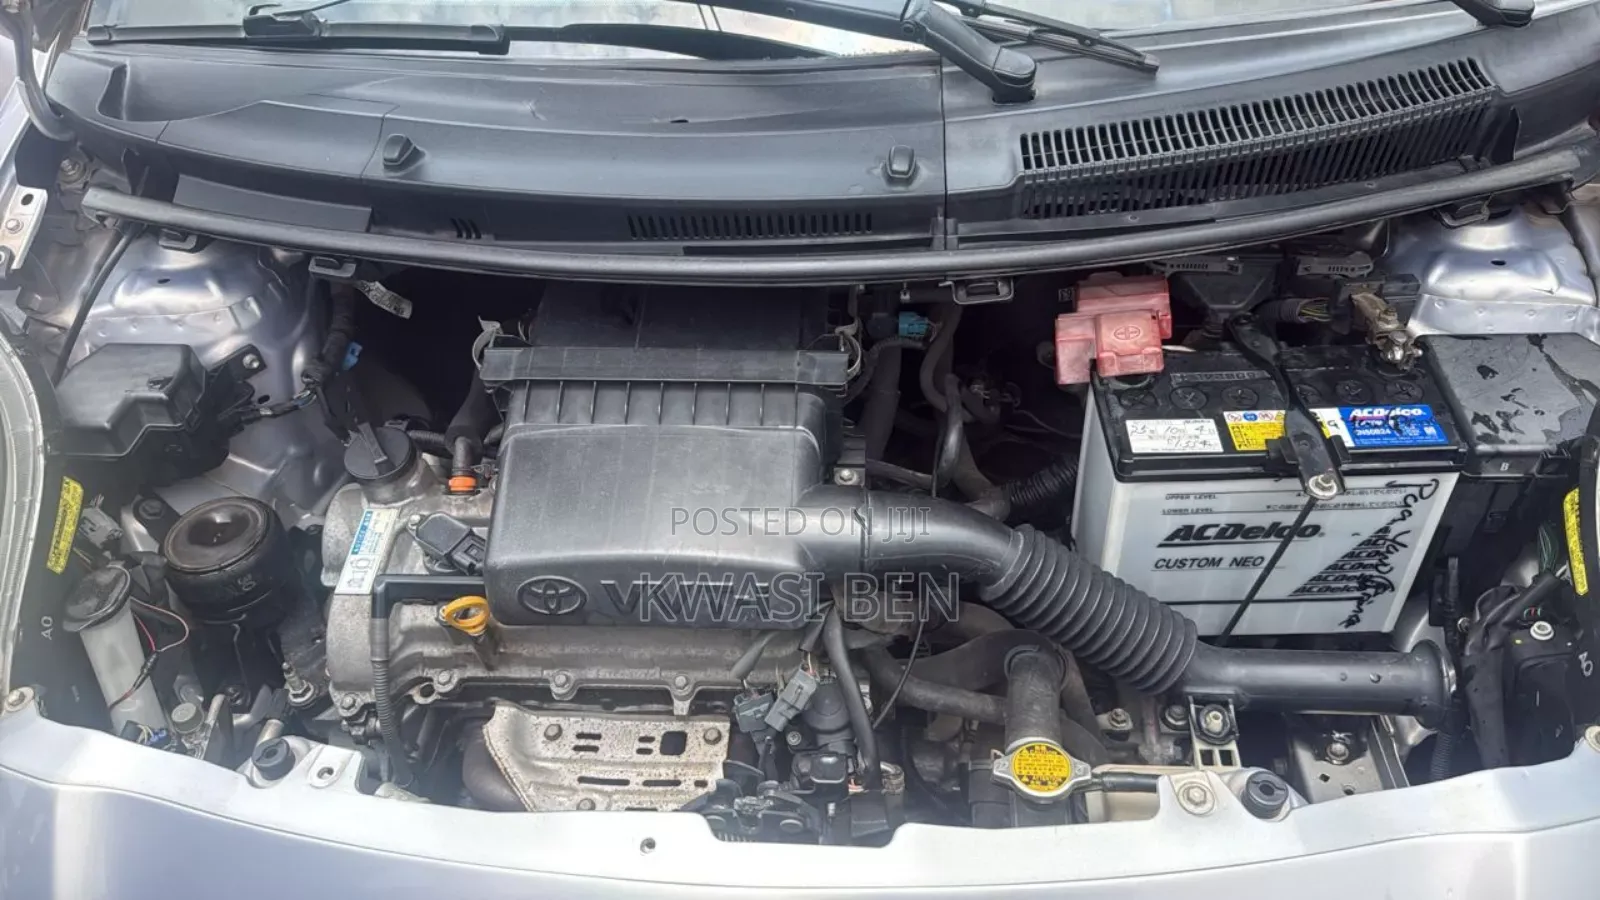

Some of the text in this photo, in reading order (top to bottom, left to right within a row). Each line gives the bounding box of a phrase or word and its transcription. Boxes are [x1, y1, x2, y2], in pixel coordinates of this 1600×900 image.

[1194, 492, 1217, 500] LEVEL
[1191, 507, 1214, 515] LEVEL
[1154, 556, 1265, 569] CUSTOM NEO
